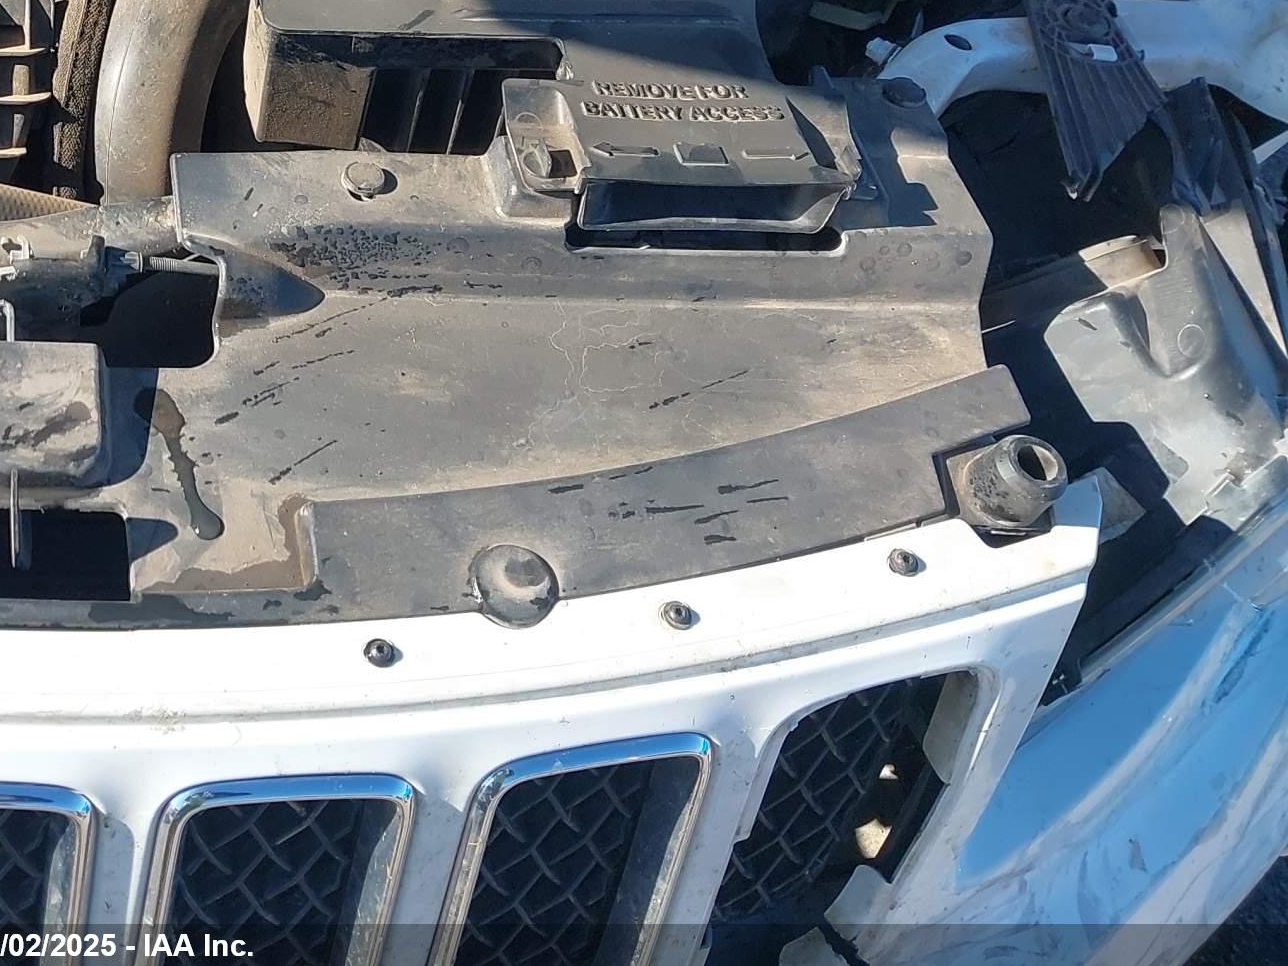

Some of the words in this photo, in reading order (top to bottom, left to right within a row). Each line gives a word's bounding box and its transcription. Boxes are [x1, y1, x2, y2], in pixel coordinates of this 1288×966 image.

[592, 80, 696, 101] REMOVE
[695, 83, 750, 101] FOR
[580, 100, 683, 122] BATTERY
[689, 105, 786, 124] ACCESS
